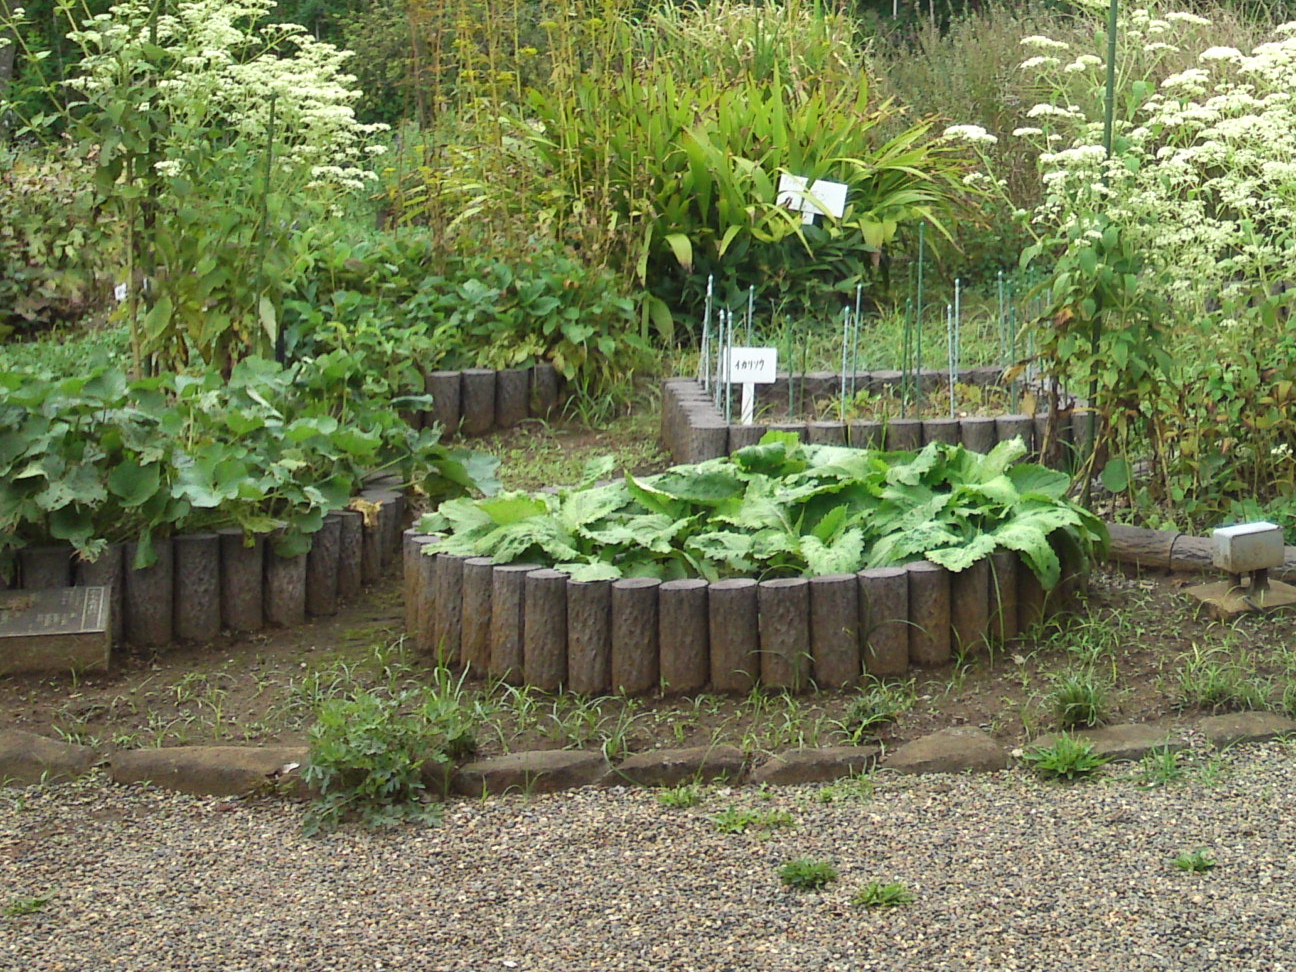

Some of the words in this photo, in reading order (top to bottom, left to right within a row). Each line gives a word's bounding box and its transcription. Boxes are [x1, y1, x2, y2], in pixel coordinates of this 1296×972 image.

[735, 359, 765, 371] イカリソウ
